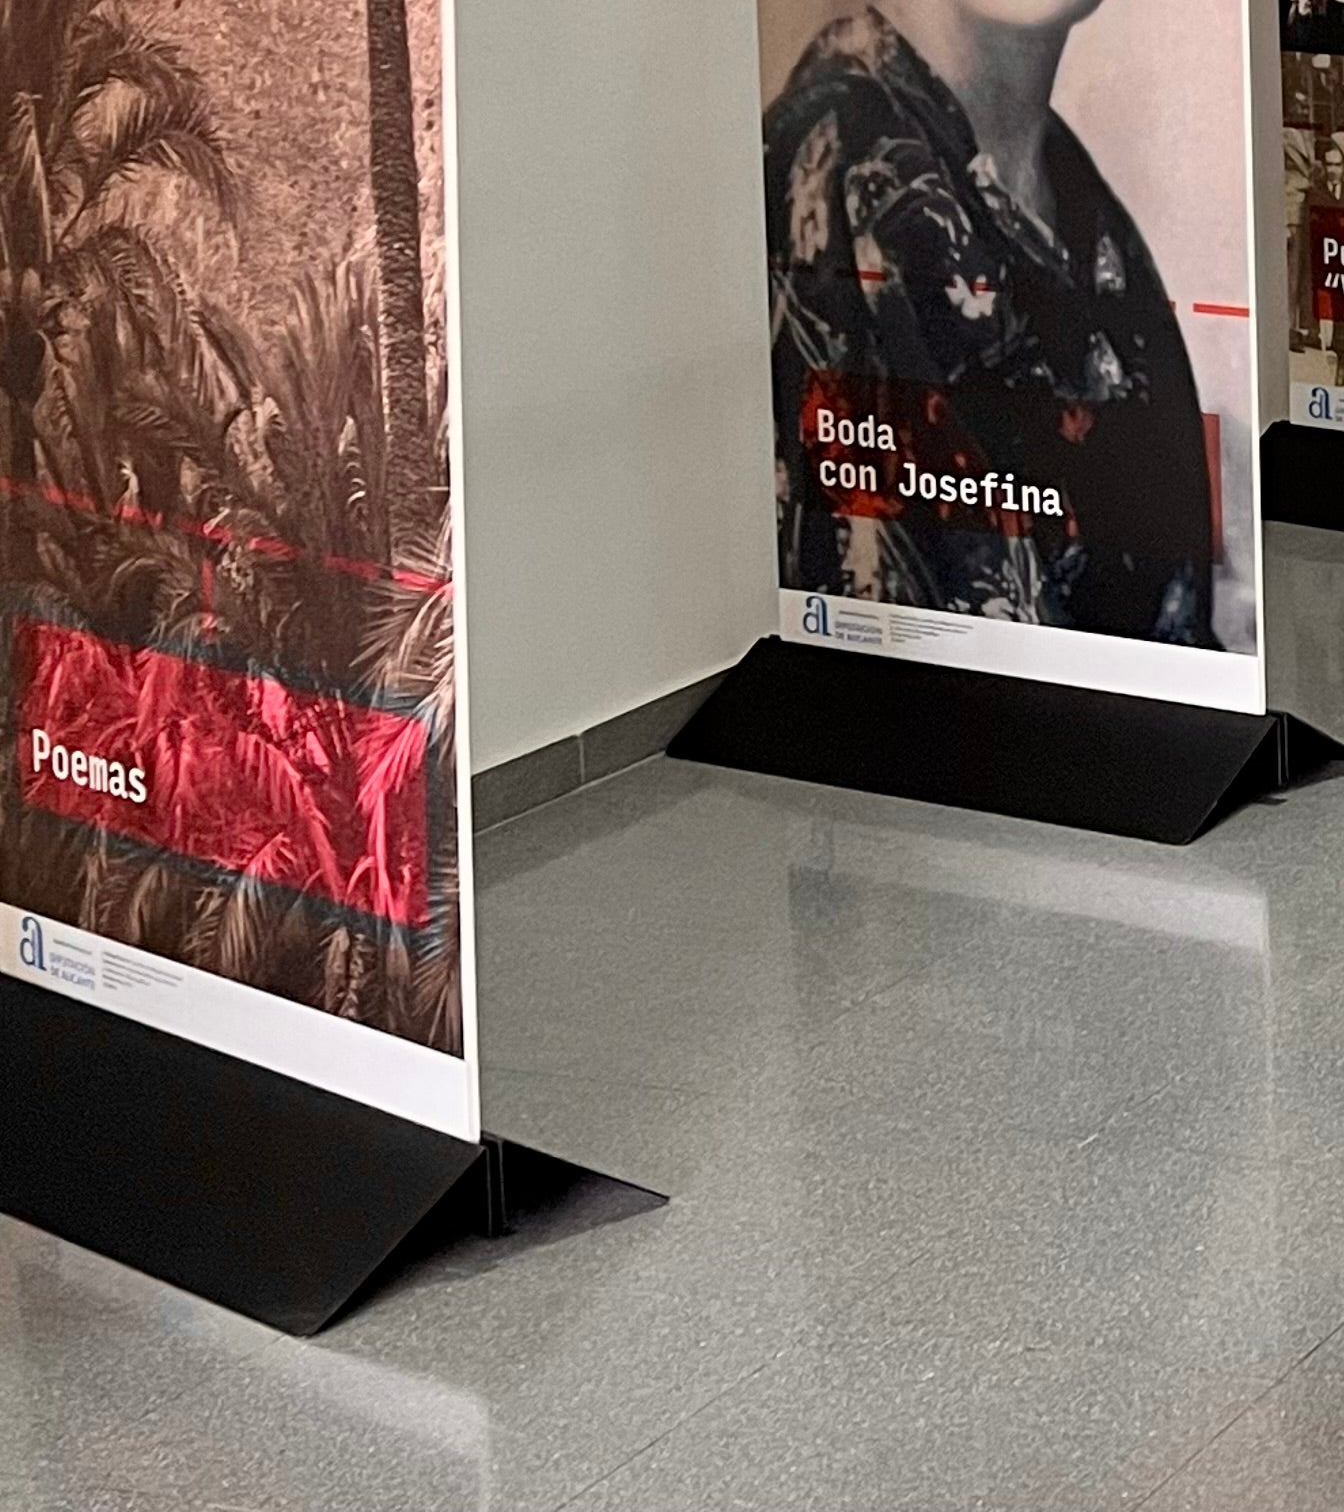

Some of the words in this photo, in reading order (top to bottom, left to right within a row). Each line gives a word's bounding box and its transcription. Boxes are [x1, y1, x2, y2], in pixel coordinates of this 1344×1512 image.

[817, 409, 896, 451] Boda
[819, 460, 877, 492] con
[899, 463, 1063, 517] Josefina
[32, 729, 147, 803] Poemas
